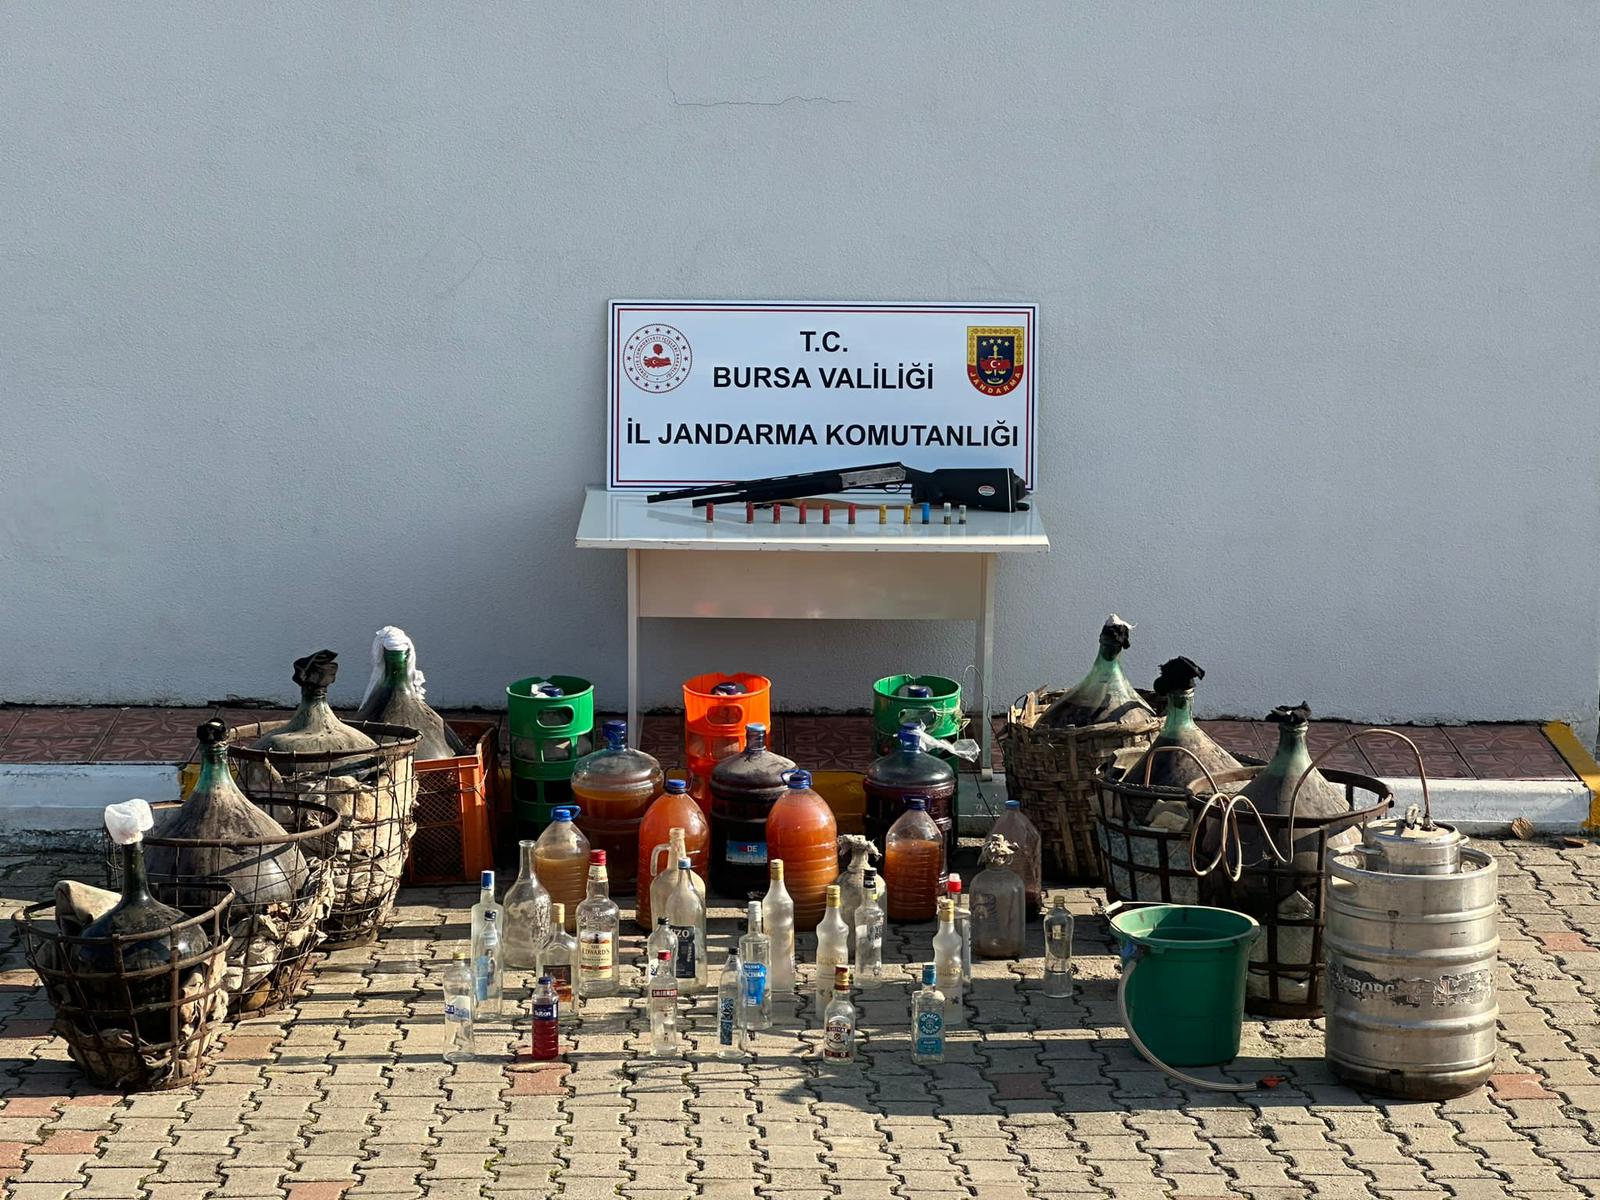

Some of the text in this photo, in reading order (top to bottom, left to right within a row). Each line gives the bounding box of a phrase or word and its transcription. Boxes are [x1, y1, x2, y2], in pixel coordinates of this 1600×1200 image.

[799, 331, 849, 353] T.C.
[712, 362, 934, 390] BURSA VALİLİĞİ
[969, 371, 1021, 394] JANDARMA
[627, 418, 1019, 447] İL JANDARMA KOMUTANLIĞI
